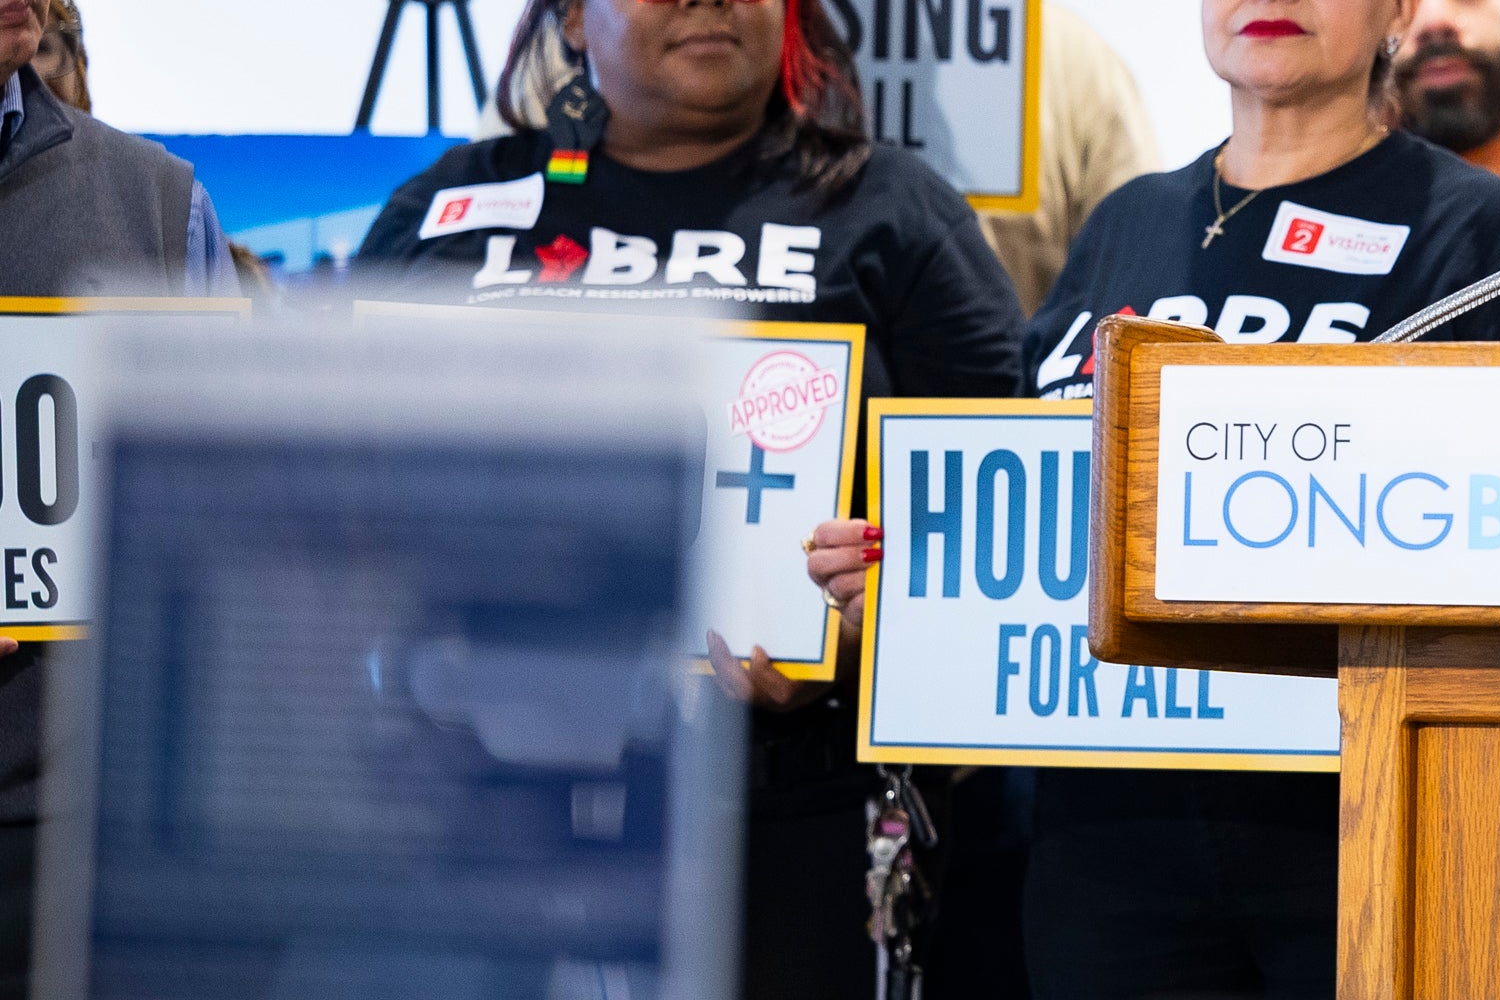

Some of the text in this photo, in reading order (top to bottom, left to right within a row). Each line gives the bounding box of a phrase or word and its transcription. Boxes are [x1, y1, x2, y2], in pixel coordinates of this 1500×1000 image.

[1289, 228, 1313, 251] 2
[518, 286, 583, 299] BEACH
[585, 288, 689, 300] RESIDENTS
[691, 287, 817, 304] EMPOWERED
[731, 373, 838, 431] APPROVED
[1186, 422, 1352, 461] CITY OF
[908, 449, 1092, 601] HOU
[996, 623, 1100, 718] FOR
